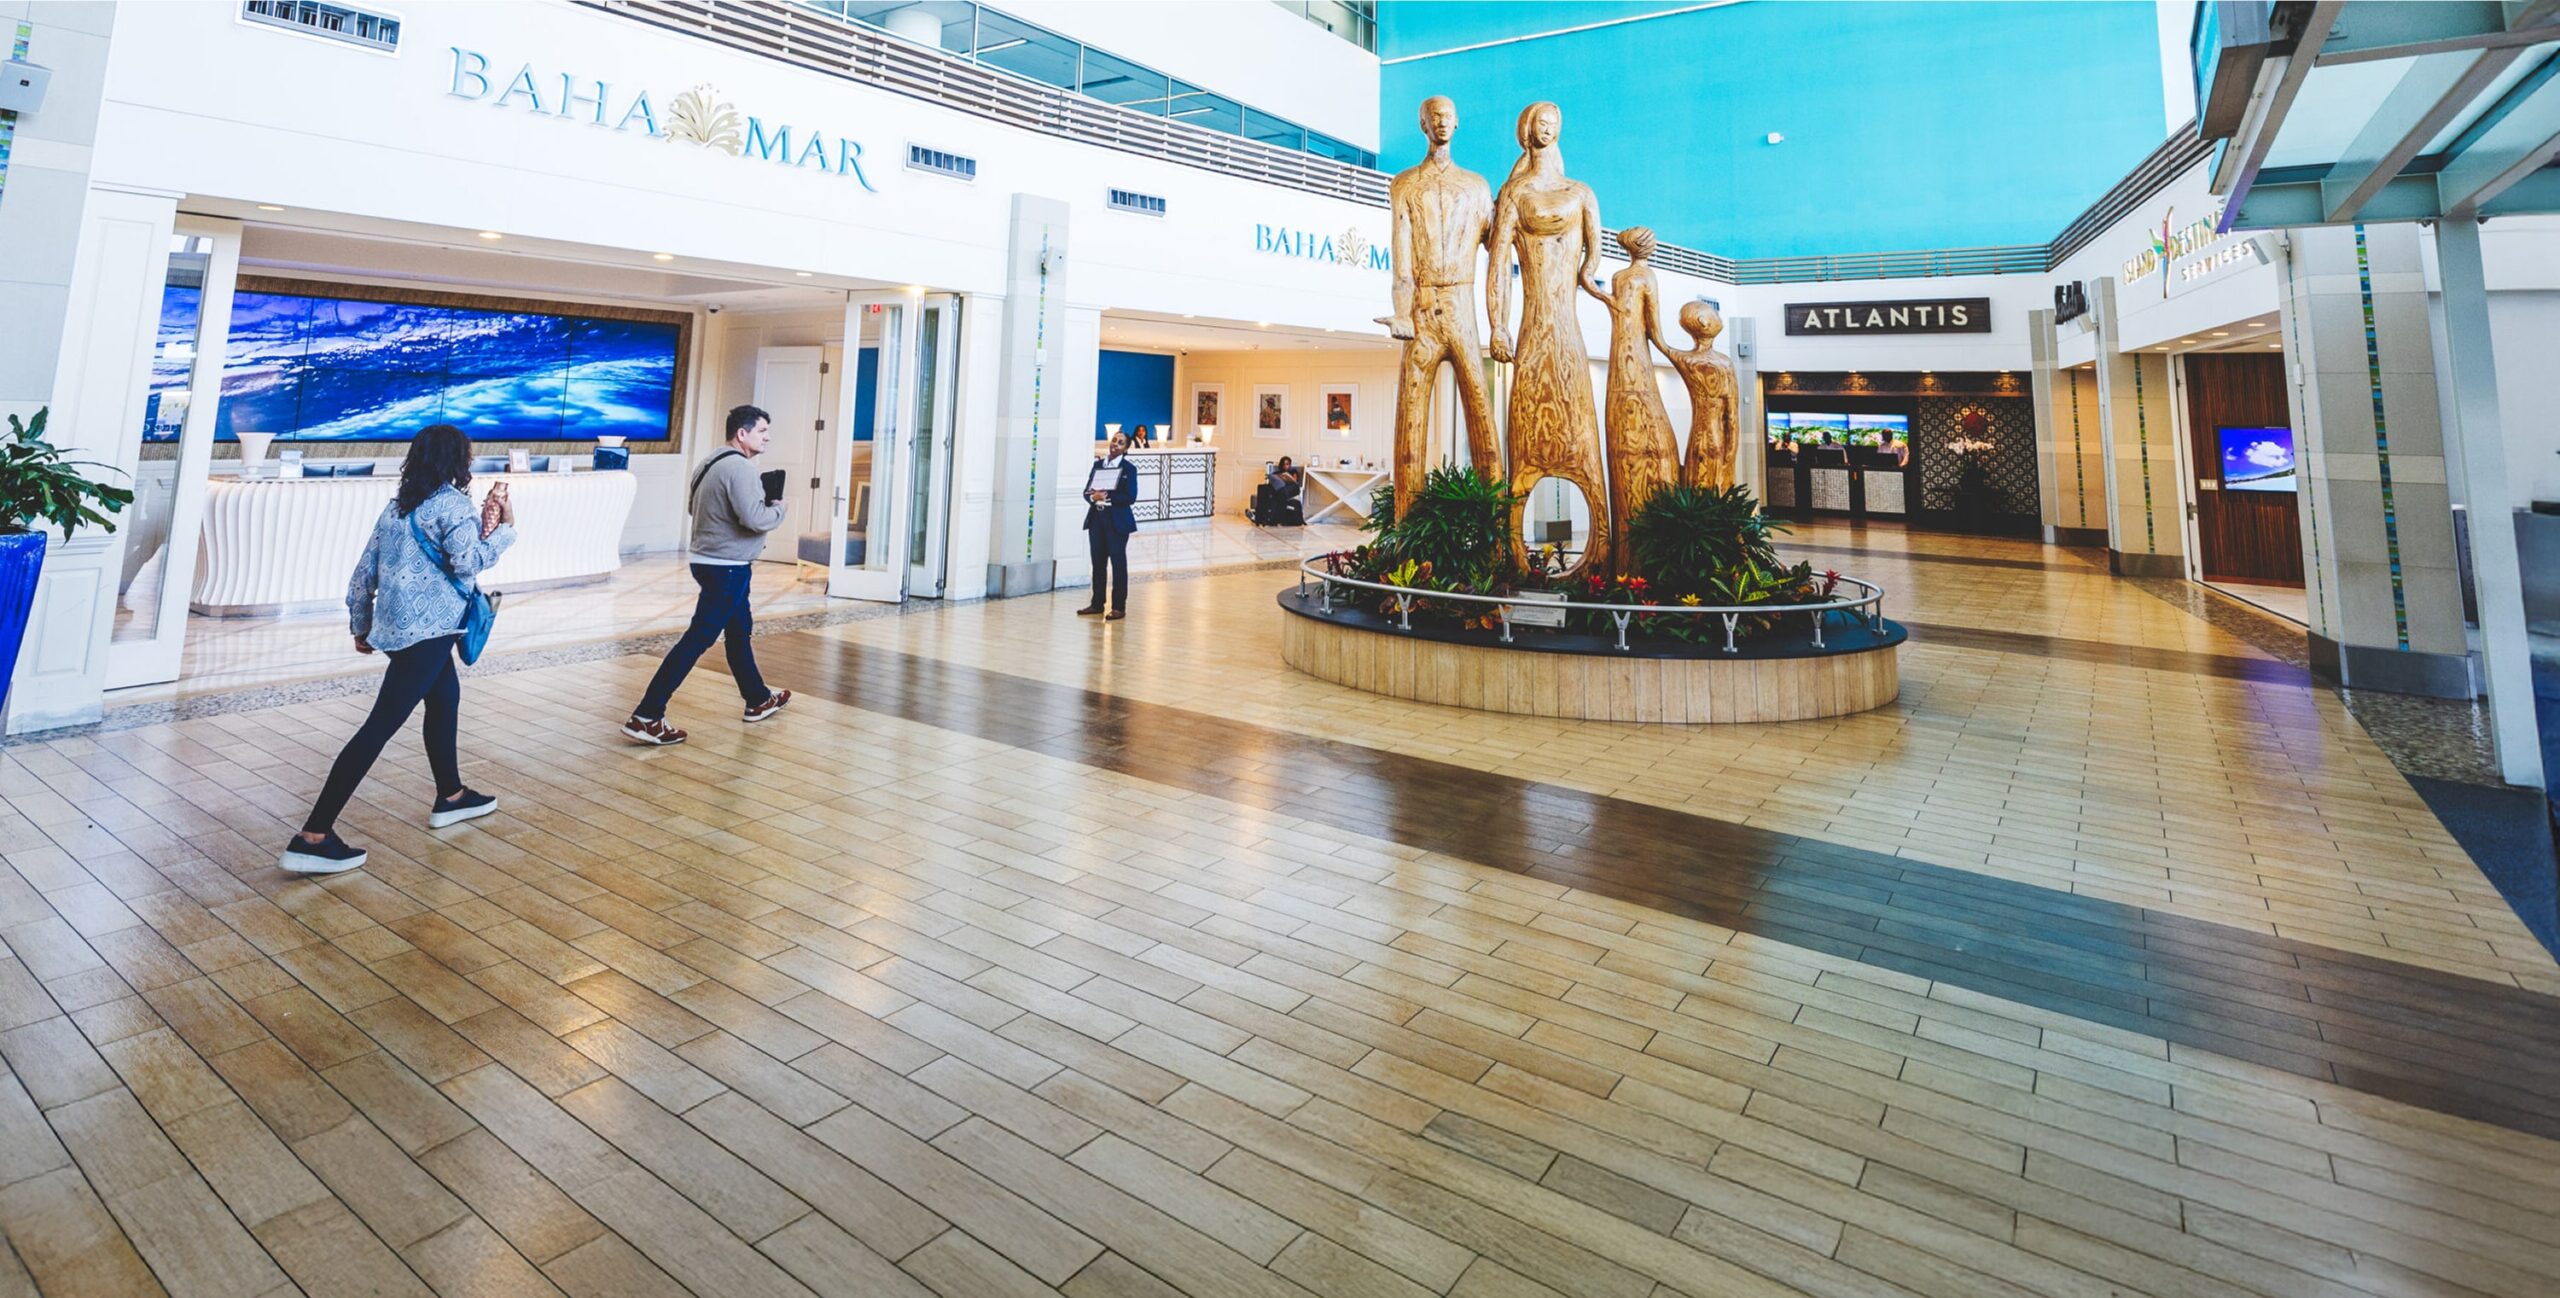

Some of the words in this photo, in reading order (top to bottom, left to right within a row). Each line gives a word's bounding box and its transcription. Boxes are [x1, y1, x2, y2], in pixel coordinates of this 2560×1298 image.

[449, 46, 668, 139] BAHA
[742, 115, 879, 193] MAR
[1256, 223, 1335, 263] BAHA
[1369, 244, 1390, 271] M
[2121, 248, 2157, 286] ISLAND
[2181, 240, 2253, 281] SERVICES
[1803, 305, 1969, 329] ATLANTIS
